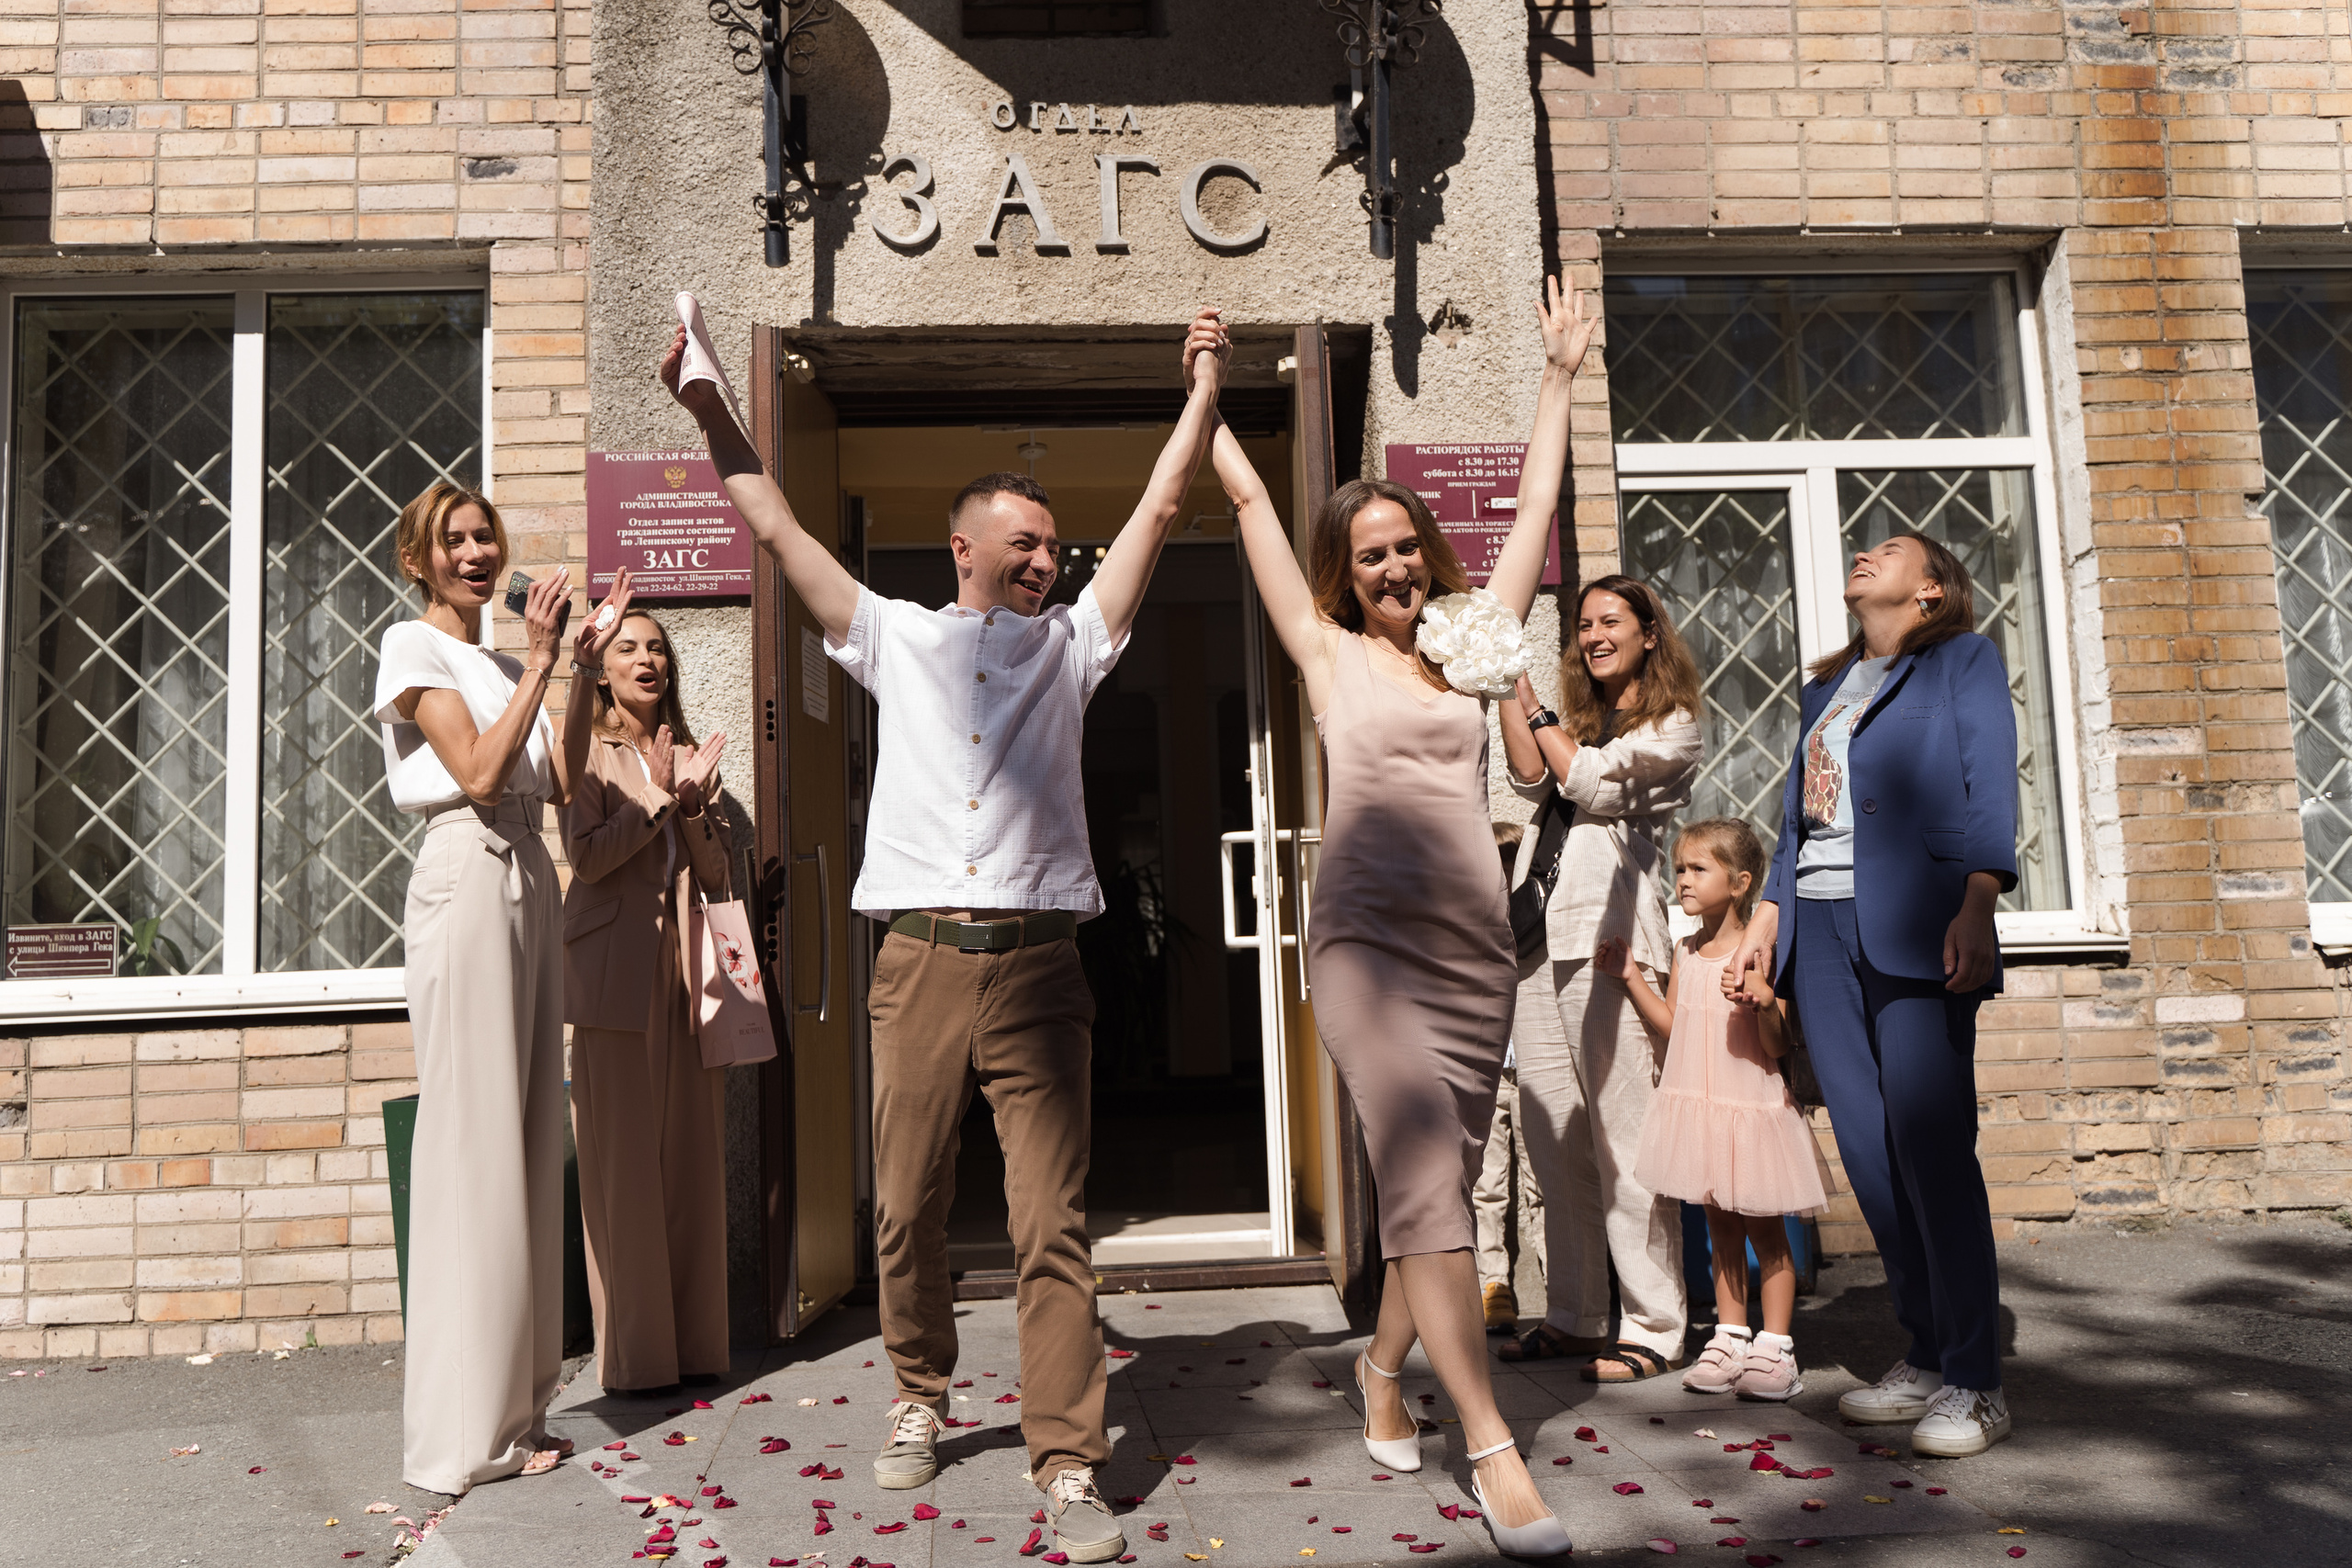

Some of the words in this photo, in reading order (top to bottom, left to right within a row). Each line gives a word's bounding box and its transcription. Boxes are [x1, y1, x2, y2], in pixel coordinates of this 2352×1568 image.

[872, 152, 1270, 250] ЗАГС
[1416, 446, 1482, 455] РАСПОРЯДОК
[1483, 445, 1525, 454] РАБОТЫ
[605, 452, 679, 462] РОССИЙСКАЯ
[681, 451, 711, 461] ФЕДЕ
[1464, 457, 1483, 467] 8.30
[1484, 458, 1496, 467] до
[1497, 457, 1521, 467] 17.30
[1422, 469, 1457, 479] суббота
[1464, 468, 1484, 479] 8.30
[1485, 470, 1496, 479] до
[1498, 468, 1521, 478] 16.15
[636, 491, 718, 502] АДМИНИСТРАЦИЯ
[620, 502, 656, 510] ГОРОДА
[657, 500, 732, 510] ВЛАДИВОСТОКА
[628, 517, 659, 526] Отдел
[661, 517, 695, 526] записи
[695, 516, 725, 525] актов
[616, 527, 684, 538] гражданского
[685, 526, 736, 536] состояния
[620, 538, 633, 547] по
[634, 536, 695, 546] Ленинскому
[696, 535, 732, 546] району
[1492, 535, 1509, 544] 8.3
[643, 548, 709, 569] ЗАГС
[650, 583, 684, 592] 22-24-62,
[685, 582, 718, 591] 22-29-22
[7, 932, 52, 943] Извините,
[55, 932, 75, 942] вход
[78, 932, 84, 941] в
[85, 930, 112, 941] ЗАГС
[17, 945, 45, 955] улицы
[48, 942, 89, 954] Шкипера
[93, 942, 113, 952] Гека
